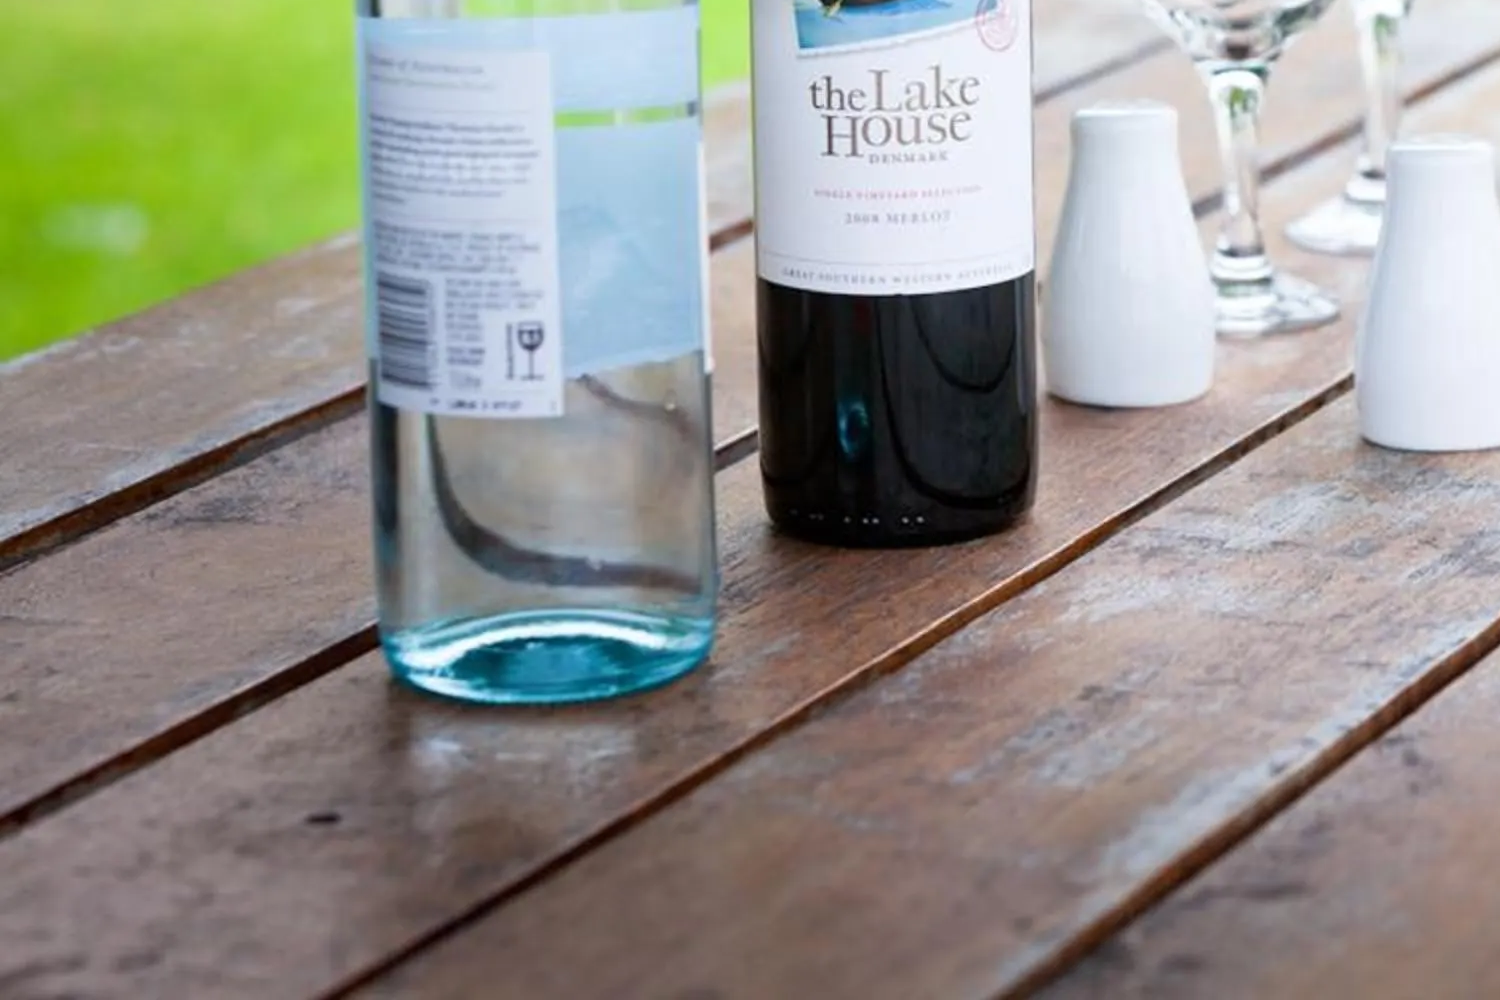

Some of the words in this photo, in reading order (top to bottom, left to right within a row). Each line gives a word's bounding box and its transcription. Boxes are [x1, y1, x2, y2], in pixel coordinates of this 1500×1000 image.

[809, 75, 867, 112] the
[867, 64, 981, 113] Lake
[820, 110, 972, 158] House
[868, 151, 949, 165] DENMARK
[885, 210, 952, 225] MERLOT
